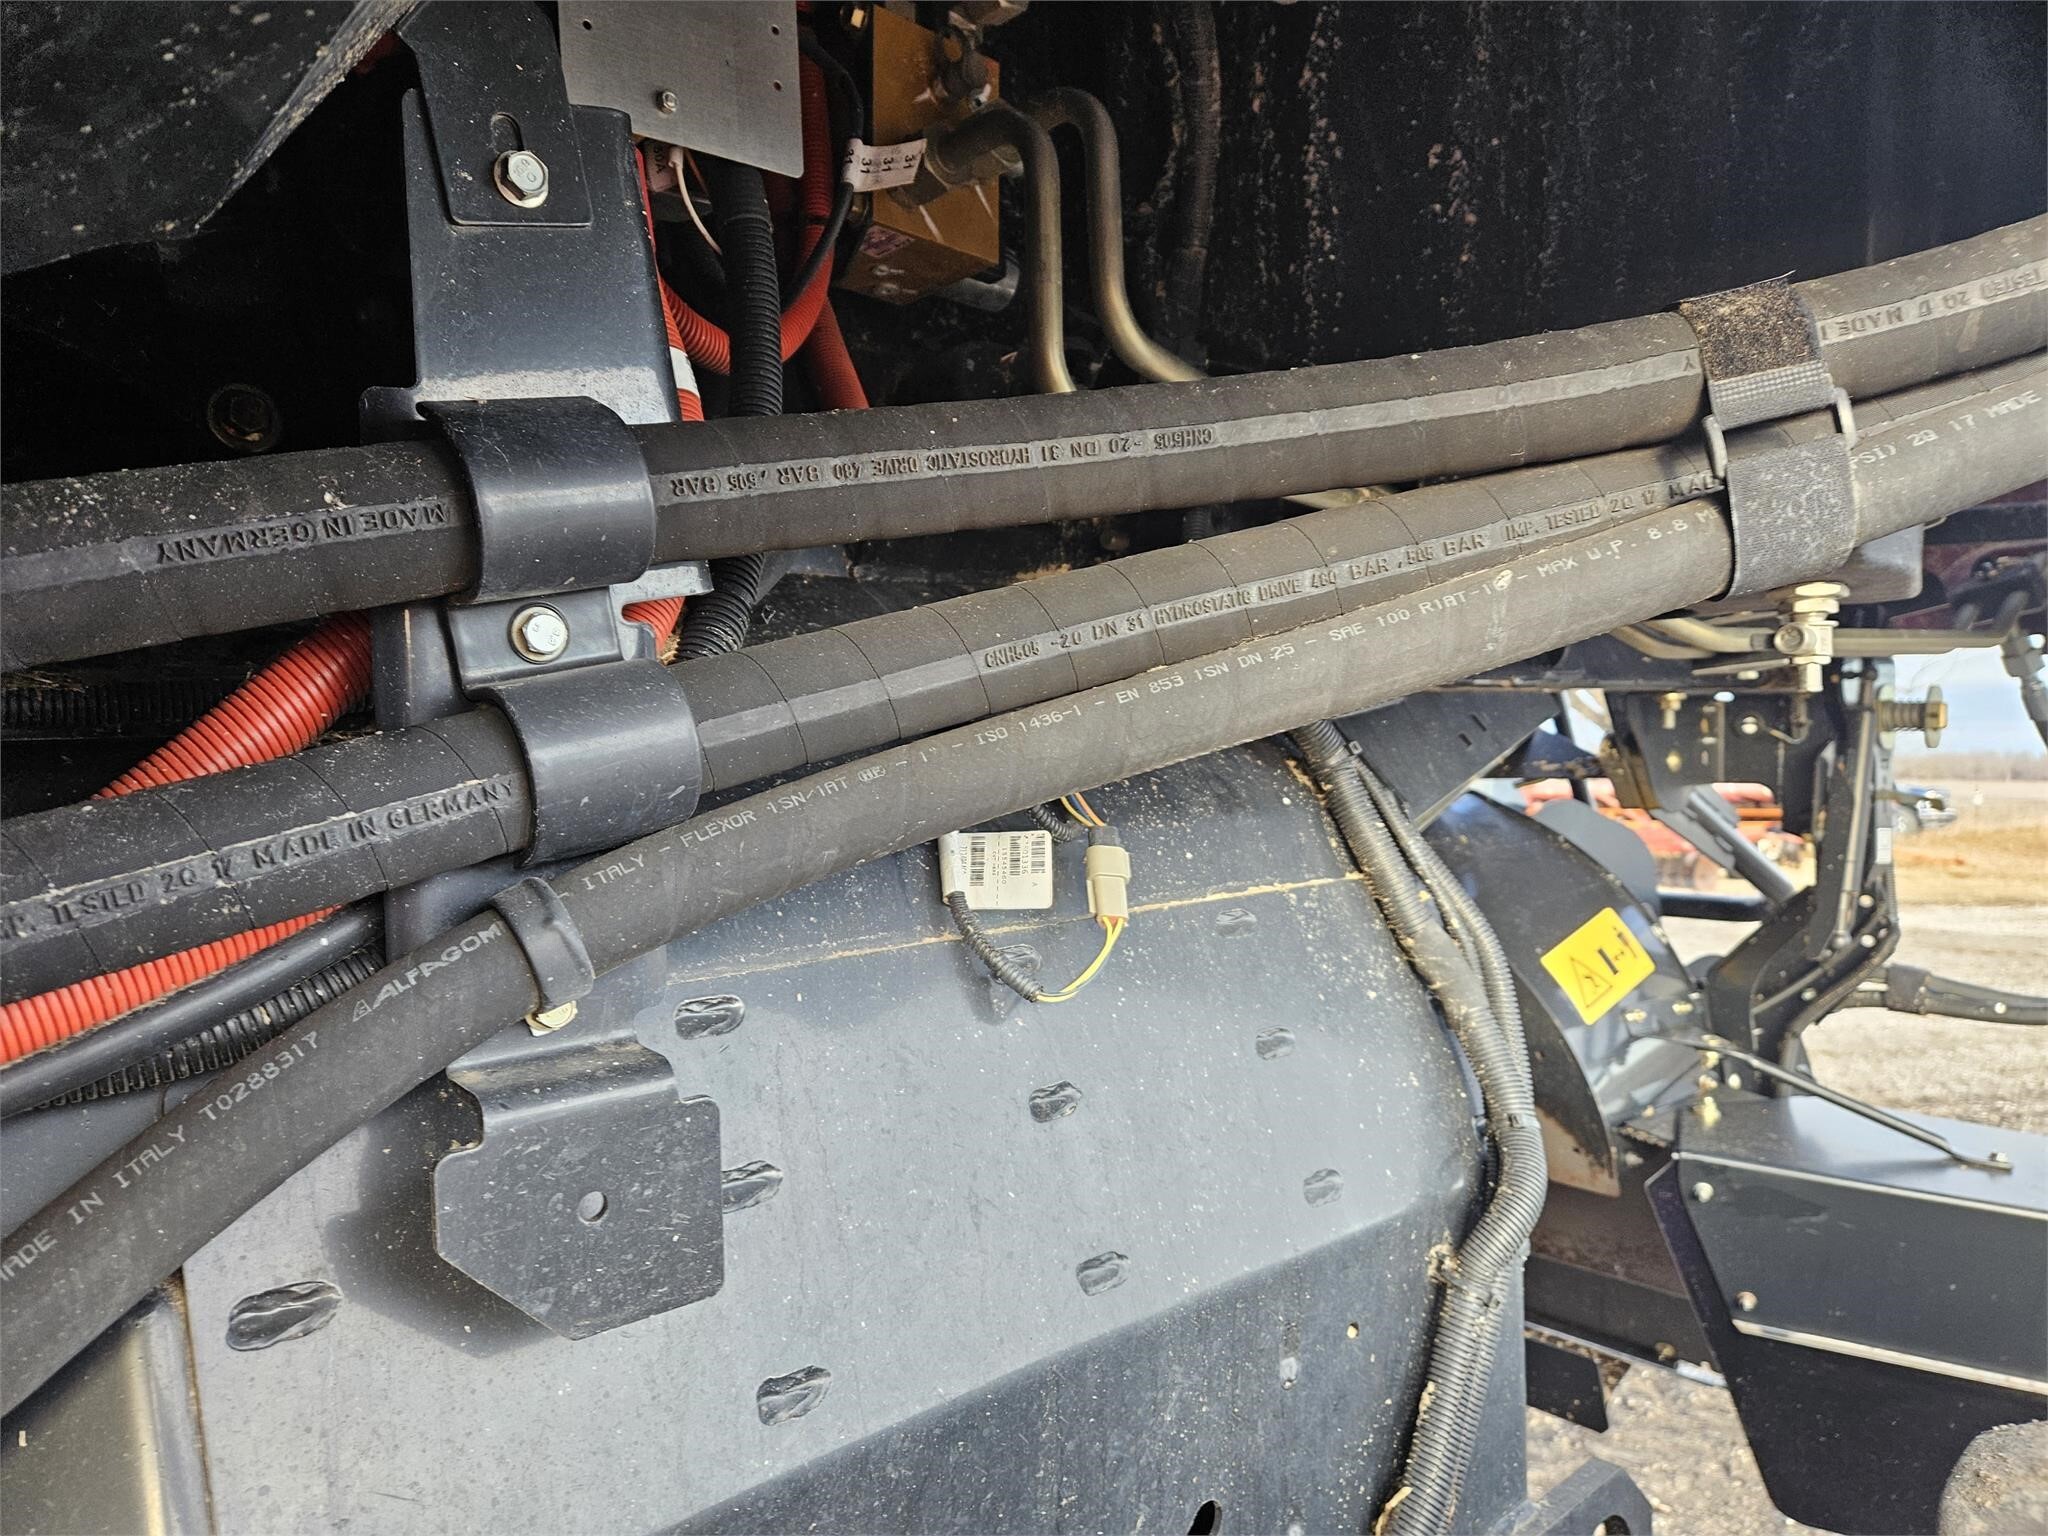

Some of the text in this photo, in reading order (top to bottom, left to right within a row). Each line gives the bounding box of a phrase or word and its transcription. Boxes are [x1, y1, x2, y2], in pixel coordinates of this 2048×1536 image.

[861, 158, 872, 174] 31
[882, 157, 894, 172] 31
[903, 154, 915, 169] 31
[1836, 307, 1905, 336] MADE
[1948, 414, 1976, 431] 17
[1983, 390, 2043, 419] MADE
[1071, 441, 1098, 458] DN
[1154, 427, 1213, 450] CNH505
[927, 447, 1031, 471] HYDROSTATIC
[1041, 445, 1061, 462] 31
[777, 465, 820, 485] BAR
[871, 456, 919, 477] DRIVE
[671, 476, 716, 497] BAR
[156, 501, 450, 565] MADE IN GERMANY
[1092, 620, 1118, 641] DN
[1154, 591, 1252, 626] HYDROSTATIC
[1258, 578, 1303, 600] DRIVE
[1350, 557, 1390, 581] BAR
[1443, 533, 1486, 557] BAR
[1545, 503, 1602, 530] TESTED
[581, 854, 646, 891] ITALY
[680, 810, 757, 848] FLEXOR
[974, 727, 1009, 745] ISO
[1019, 704, 1082, 733] 1436-1
[1115, 687, 1140, 704] EN
[1149, 674, 1185, 693] 853
[1195, 662, 1230, 681] 1SN
[1237, 652, 1264, 669] DN
[1270, 642, 1296, 661] 25
[1329, 622, 1366, 642] SAE
[1375, 608, 1411, 627] 100
[1536, 557, 1580, 578] MAX
[1647, 519, 1688, 540] 8.8
[253, 830, 342, 869] MADE
[348, 816, 379, 842] IN
[387, 780, 514, 831] GERMANY
[67, 1191, 104, 1225] IN
[112, 1124, 186, 1189] ITALY
